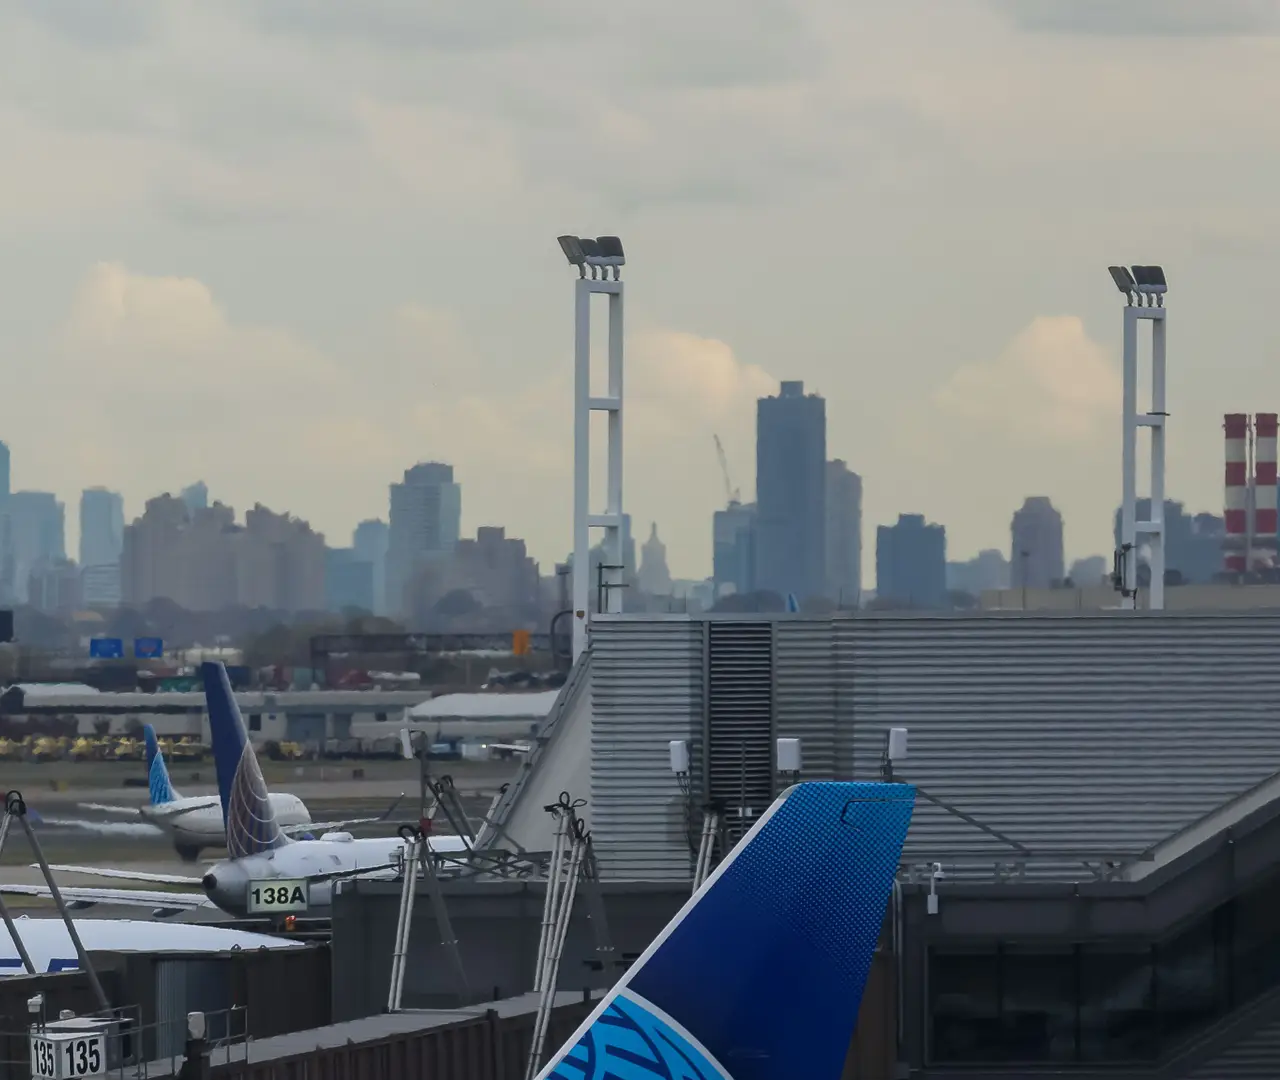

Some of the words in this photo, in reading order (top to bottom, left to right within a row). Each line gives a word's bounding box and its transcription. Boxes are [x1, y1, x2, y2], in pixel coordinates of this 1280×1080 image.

[251, 886, 306, 905] 138A
[32, 1040, 55, 1078] 135
[64, 1039, 101, 1077] 135
